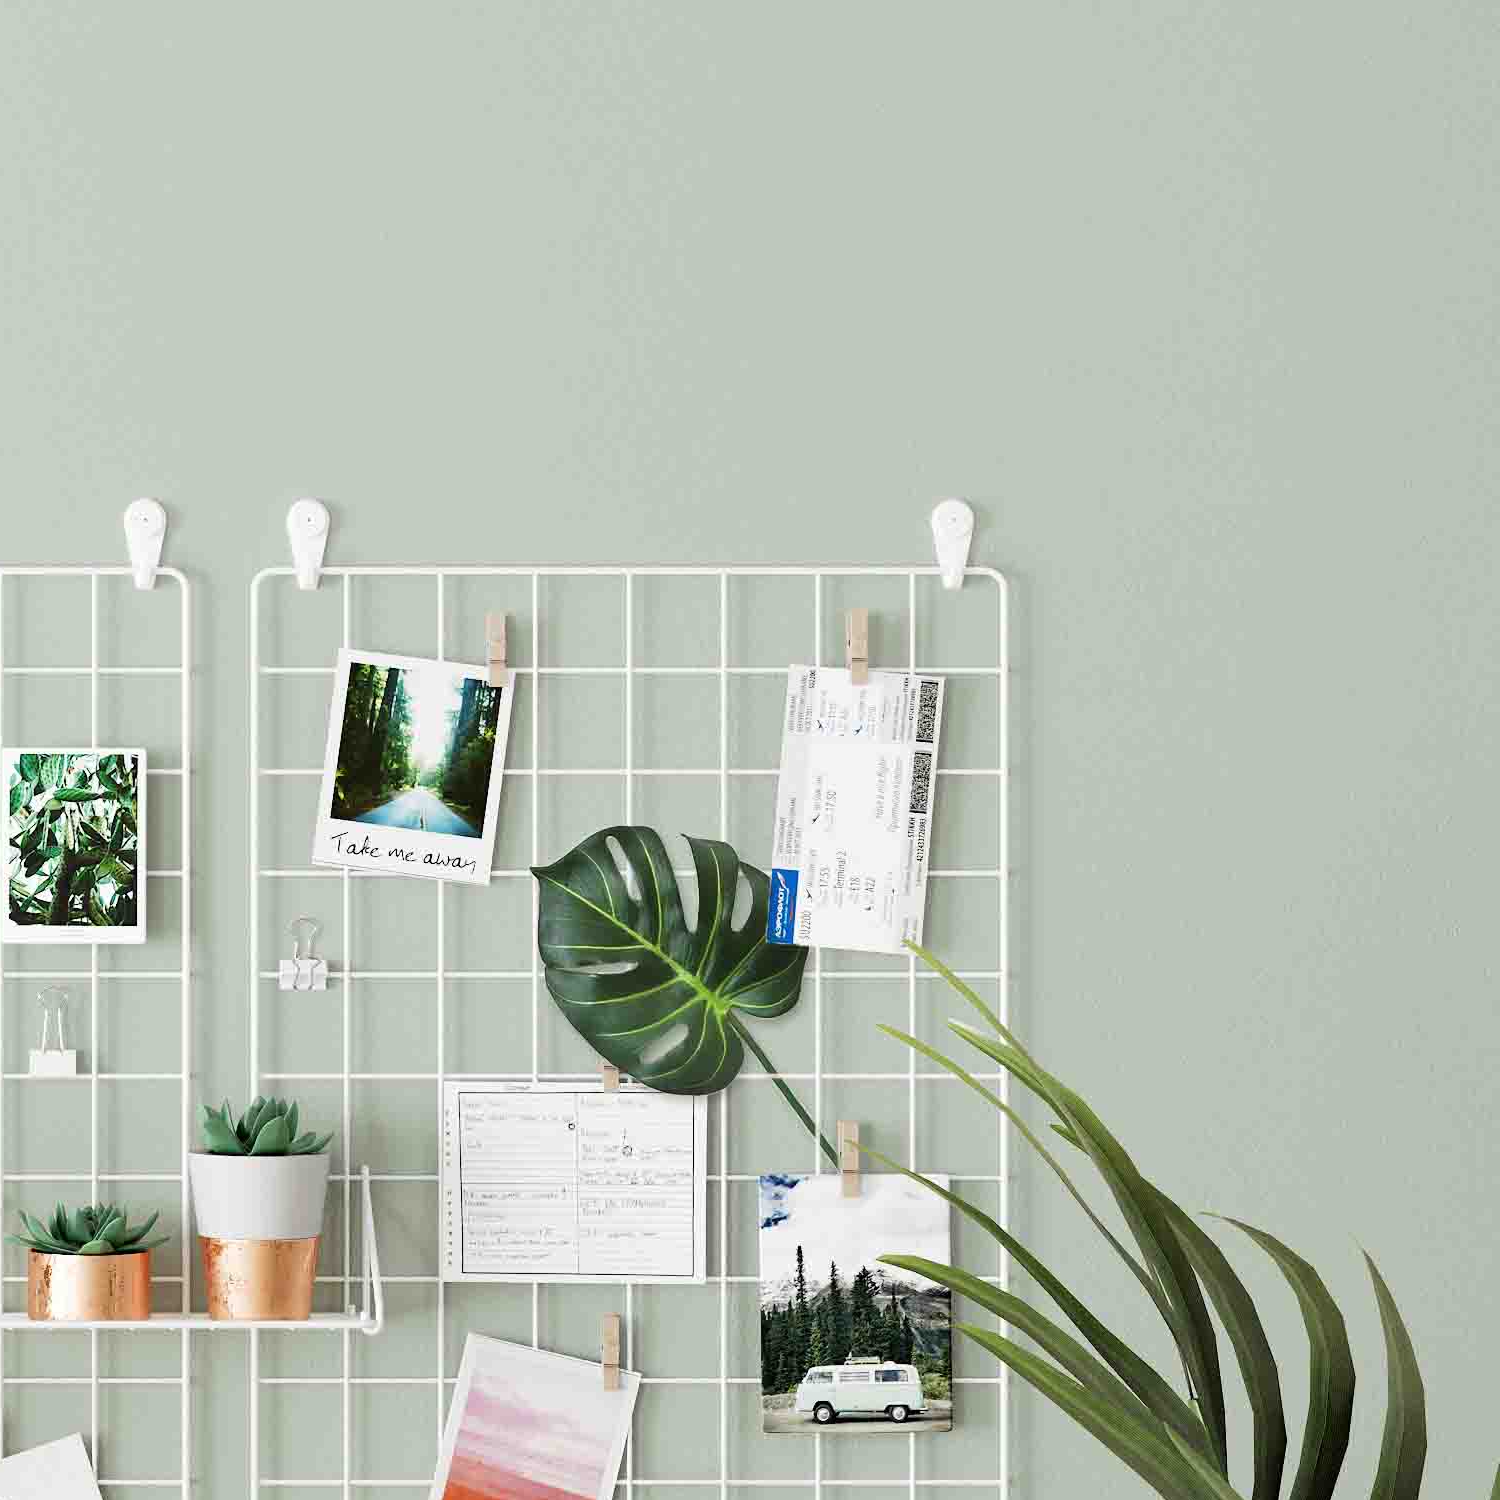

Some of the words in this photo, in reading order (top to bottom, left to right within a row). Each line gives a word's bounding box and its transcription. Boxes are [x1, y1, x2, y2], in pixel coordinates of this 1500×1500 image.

[331, 831, 381, 857] Take
[389, 847, 415, 862] me
[423, 853, 476, 874] away
[774, 885, 787, 938] АЭРОФЛОТ
